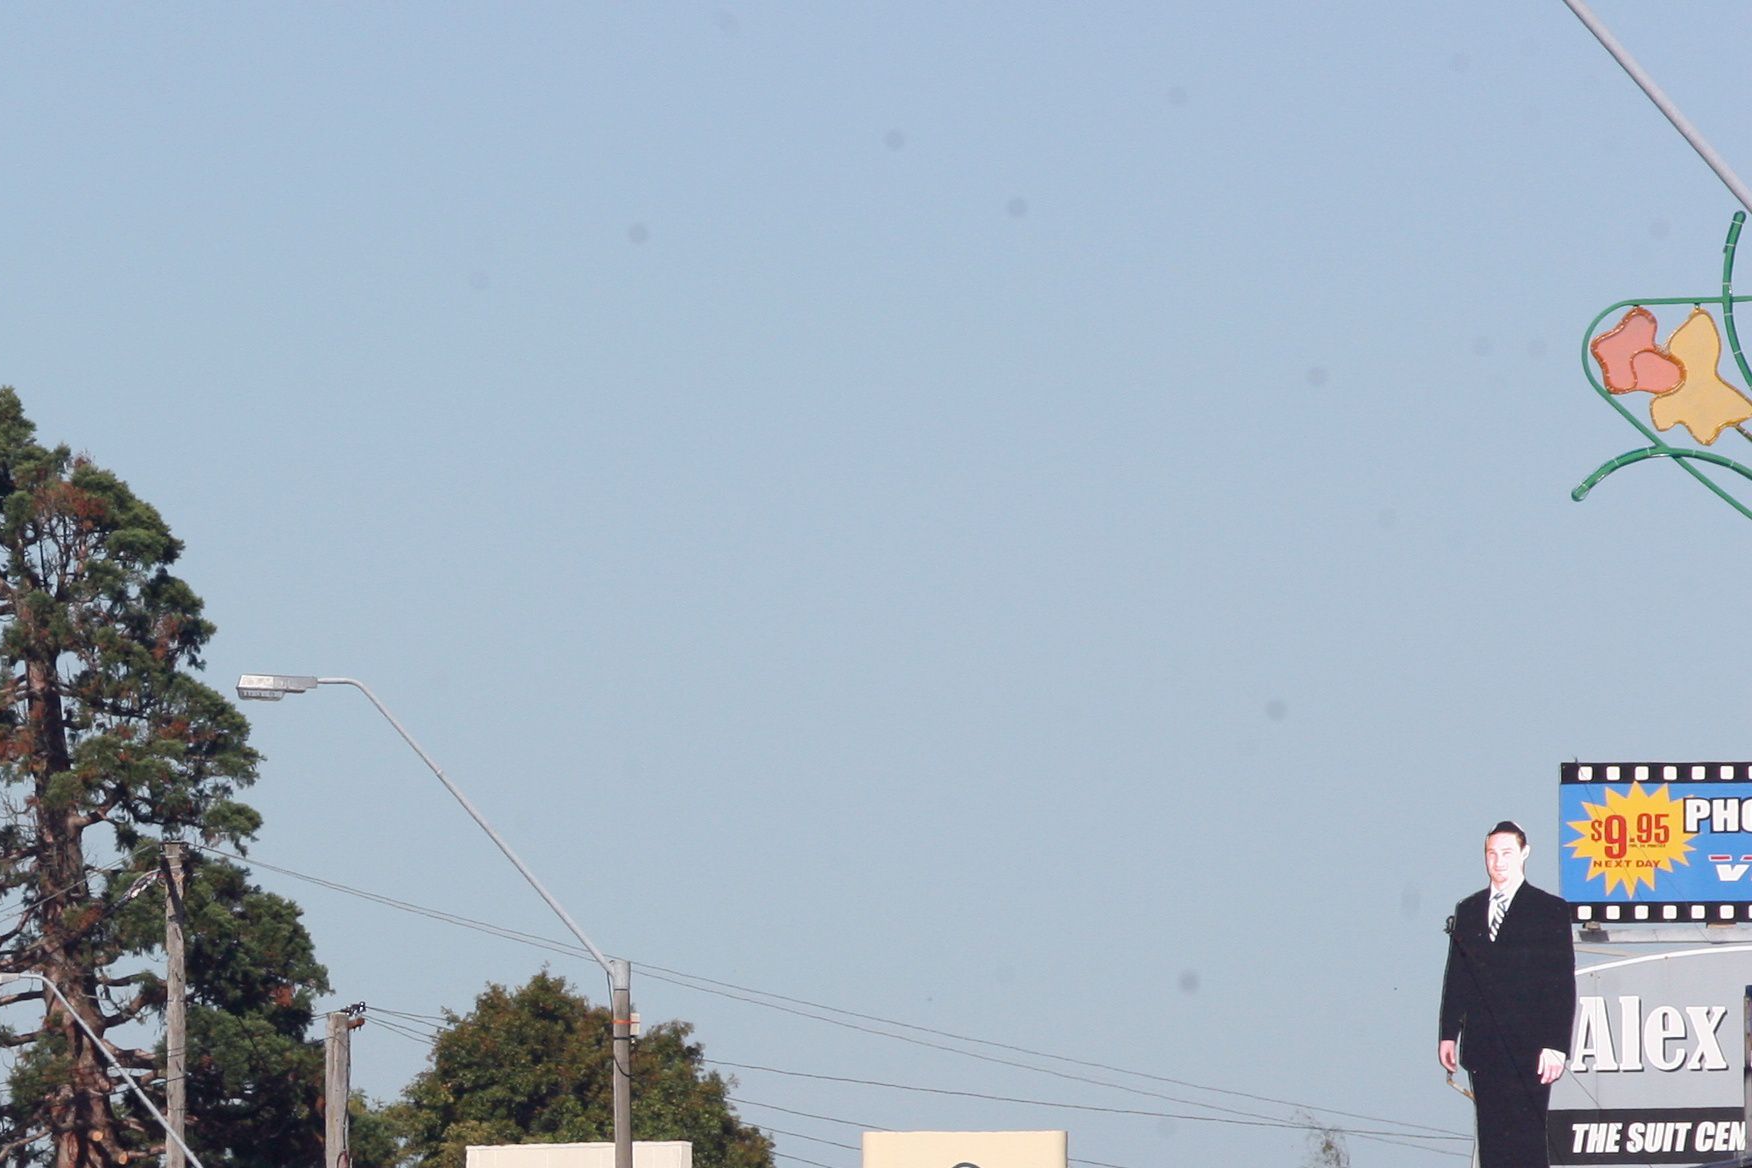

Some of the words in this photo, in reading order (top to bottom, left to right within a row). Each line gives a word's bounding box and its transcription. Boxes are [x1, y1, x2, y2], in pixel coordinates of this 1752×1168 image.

[1591, 813, 1670, 859] $9.95
[1593, 860, 1632, 869] NEXT
[1636, 860, 1662, 869] DAY
[1570, 995, 1728, 1073] Alex
[1572, 1123, 1623, 1153] THE
[1626, 1122, 1692, 1153] SUIT
